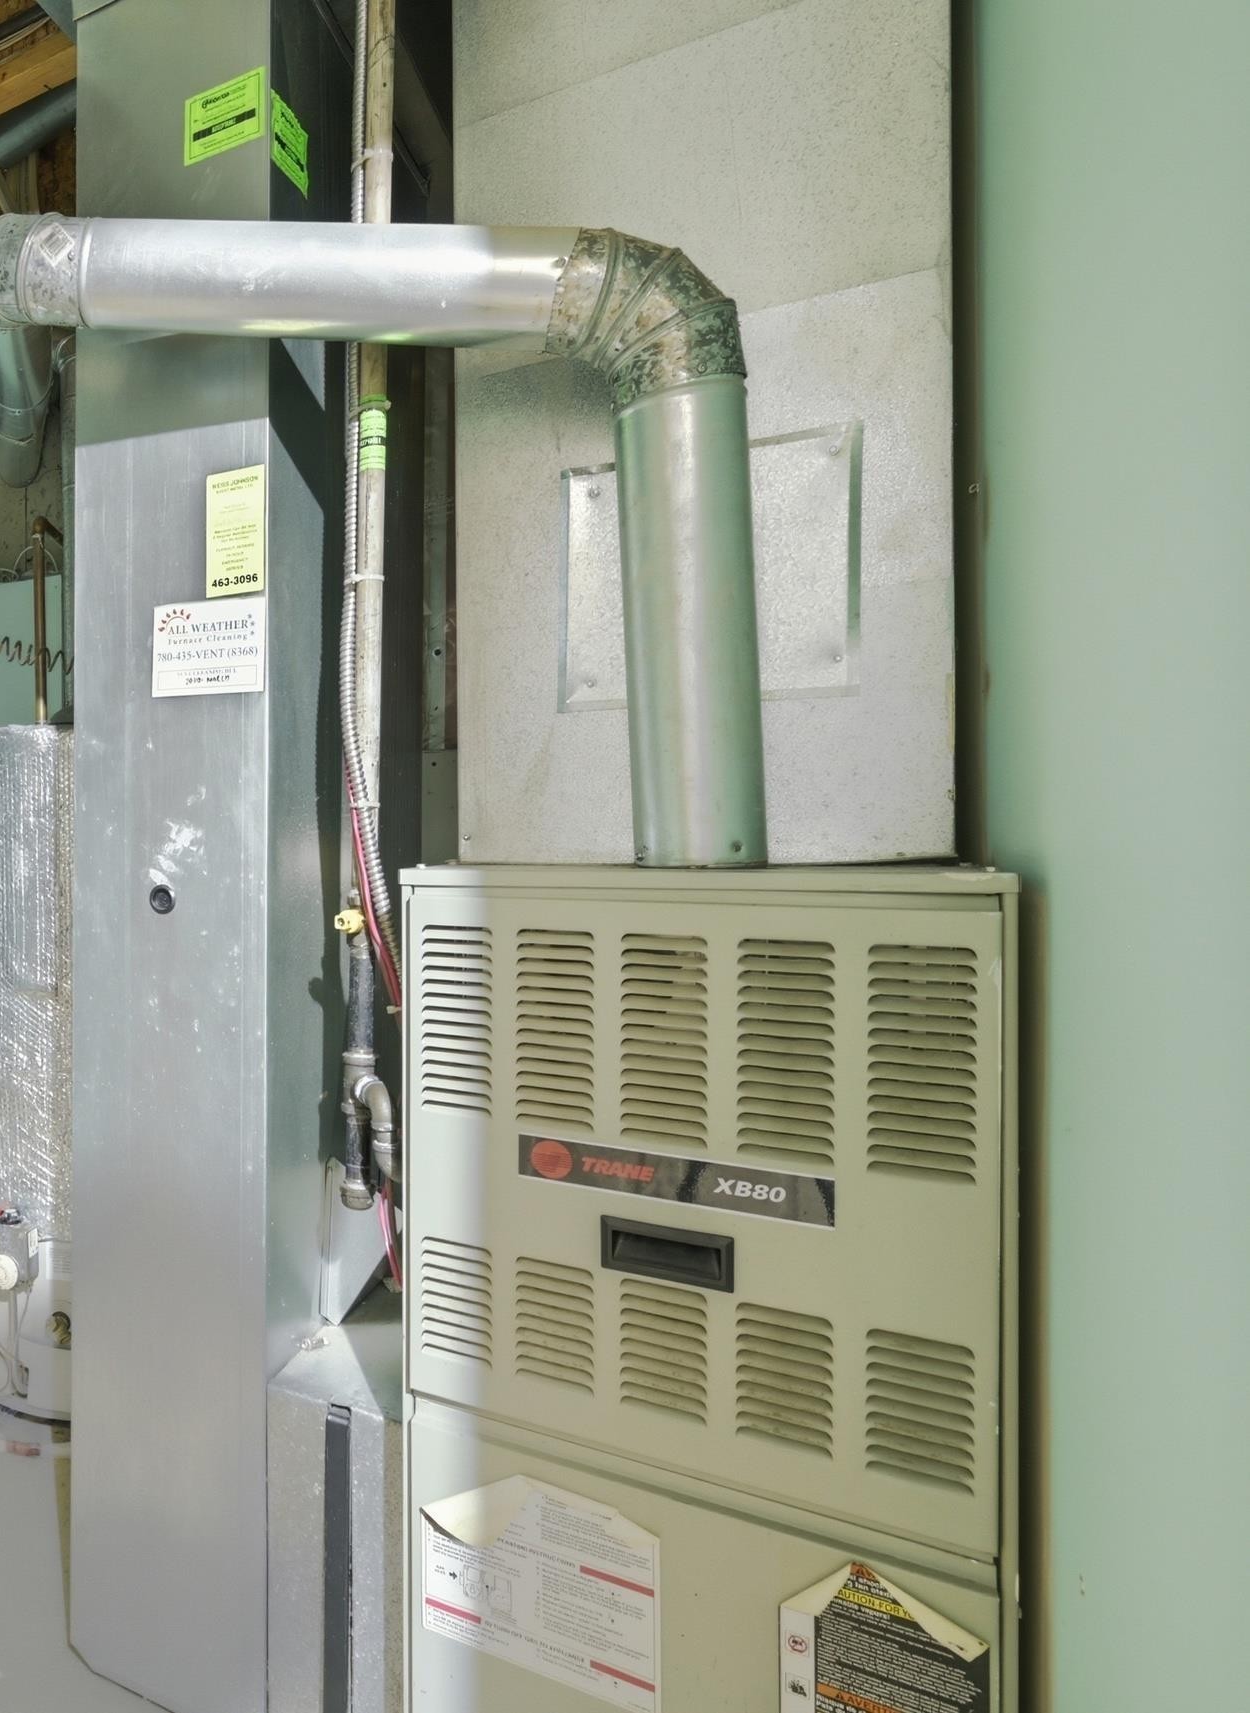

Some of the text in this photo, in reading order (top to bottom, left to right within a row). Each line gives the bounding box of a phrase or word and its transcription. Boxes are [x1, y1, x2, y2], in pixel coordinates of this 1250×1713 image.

[211, 573, 258, 588] 463-3096
[168, 619, 248, 635] ALL WEATHER
[168, 633, 248, 645] Furnace Cleaning
[157, 646, 258, 662] 780-435-VENT (8368)
[582, 1157, 786, 1203] TRANE XB80
[837, 1588, 876, 1608] AUTION
[878, 1602, 900, 1615] FOR
